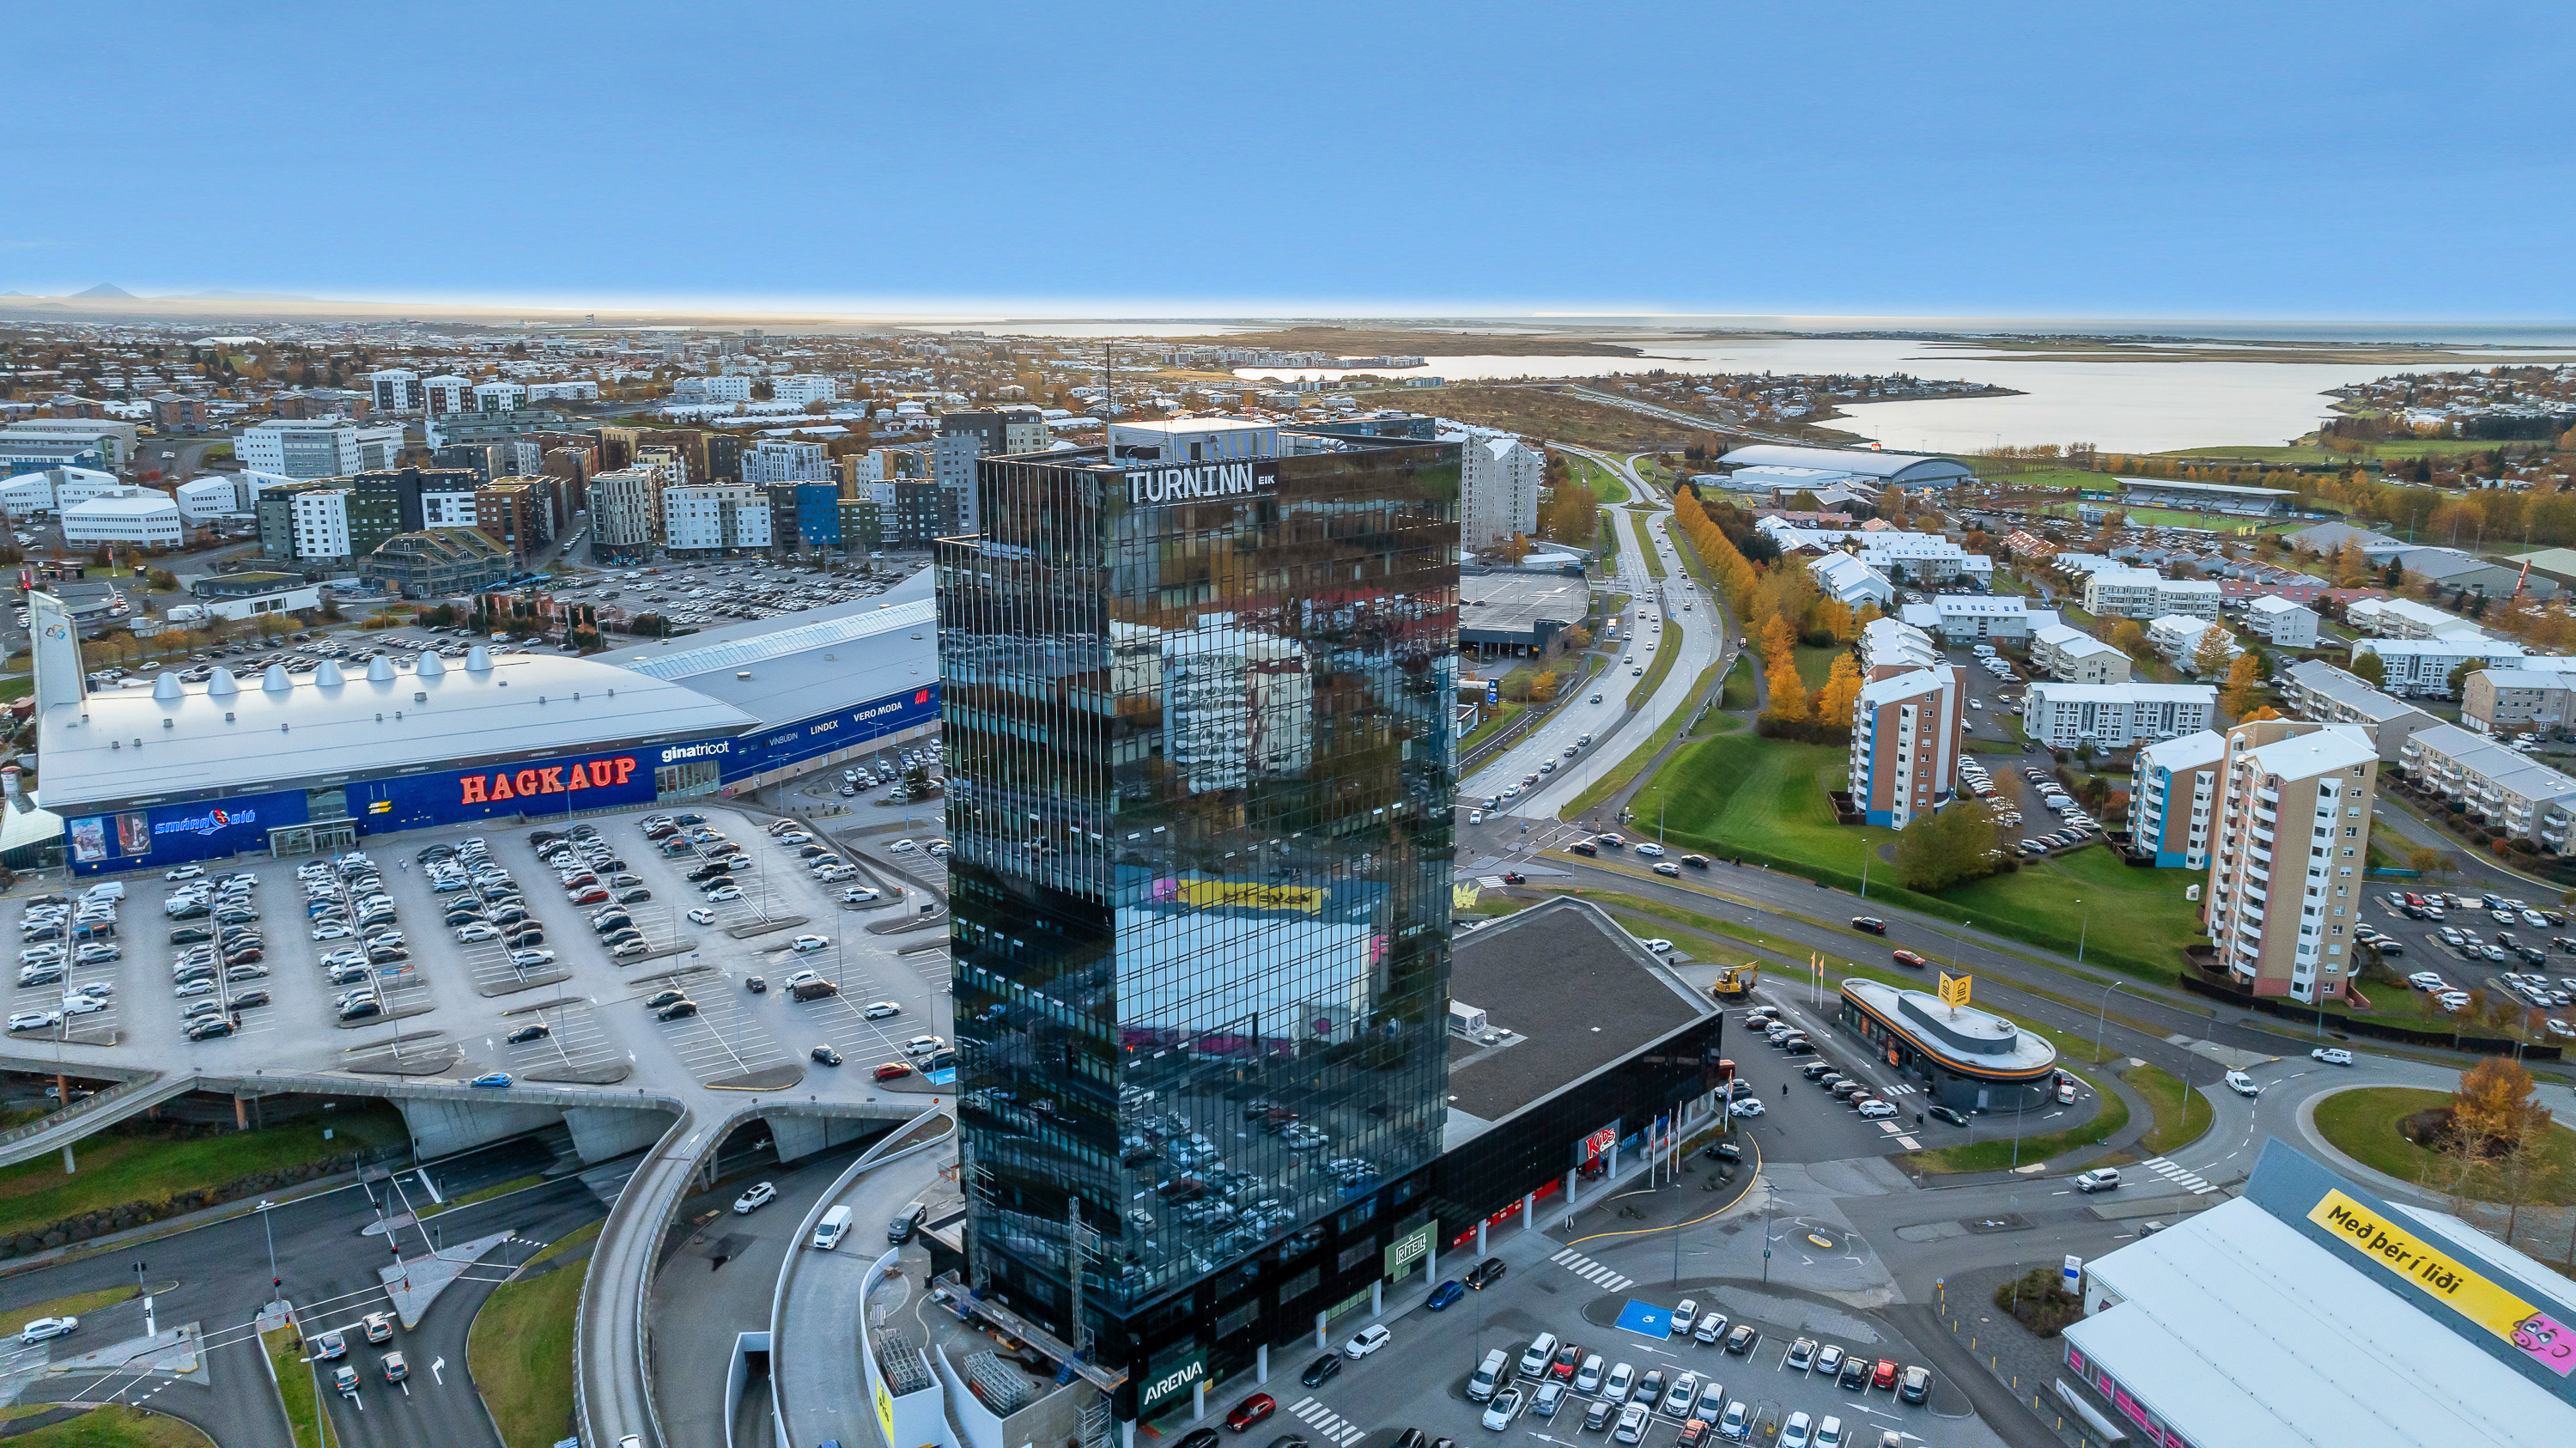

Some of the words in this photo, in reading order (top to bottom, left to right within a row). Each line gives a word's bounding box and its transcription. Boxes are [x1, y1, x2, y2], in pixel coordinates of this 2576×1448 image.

[1126, 463, 1253, 503] TURNINN
[1258, 475, 1275, 485] EIK
[811, 720, 838, 735] LINDEX
[854, 709, 876, 722] VERO
[878, 702, 902, 715] MODA
[459, 756, 637, 805] HAGKAUP
[2328, 1205, 2375, 1238] Með
[2367, 1232, 2411, 1262] þér
[2408, 1256, 2427, 1271] í
[2421, 1263, 2464, 1294] liði
[1145, 1361, 1202, 1405] ARENA
